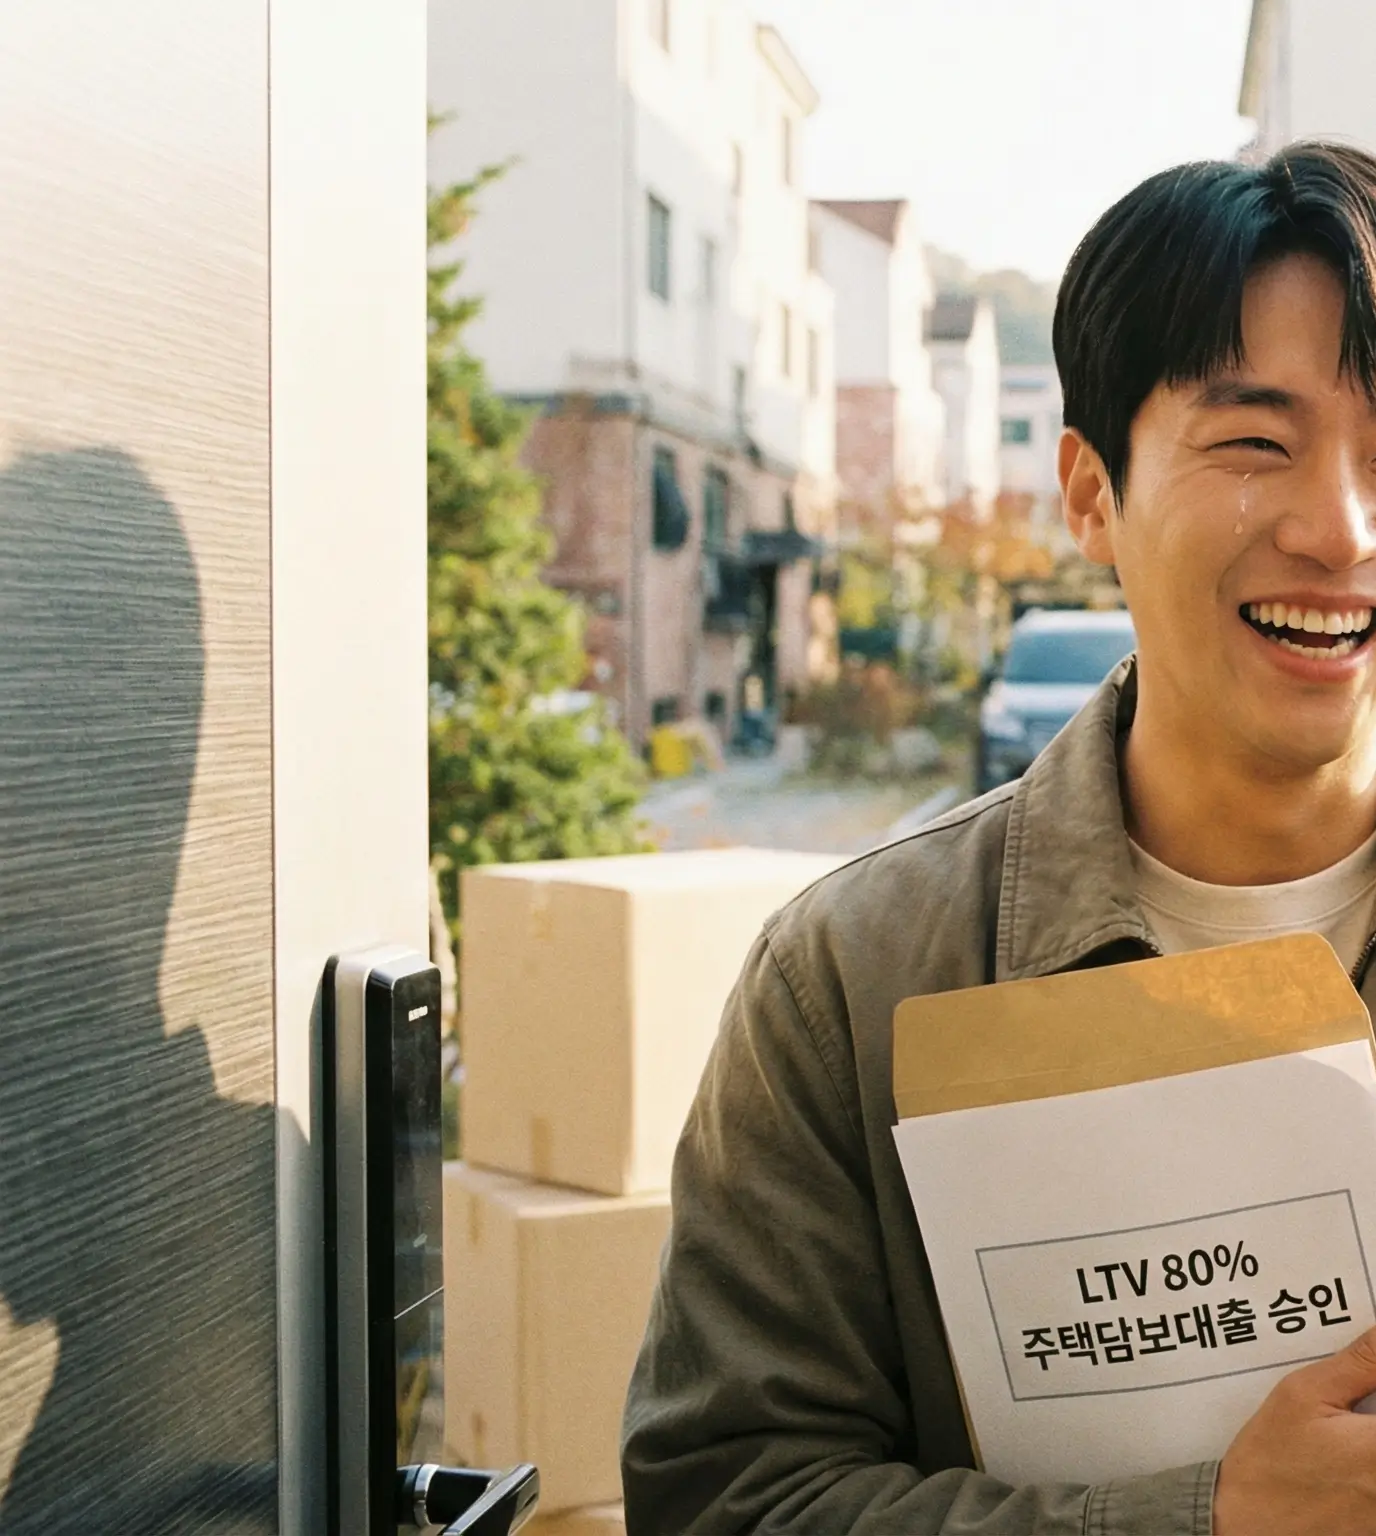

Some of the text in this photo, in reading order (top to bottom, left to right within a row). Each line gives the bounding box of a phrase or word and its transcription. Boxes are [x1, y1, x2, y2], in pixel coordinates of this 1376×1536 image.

[1075, 1240, 1259, 1304] LTV 80%
[1021, 1277, 1352, 1371] 주택담보대출 승인
